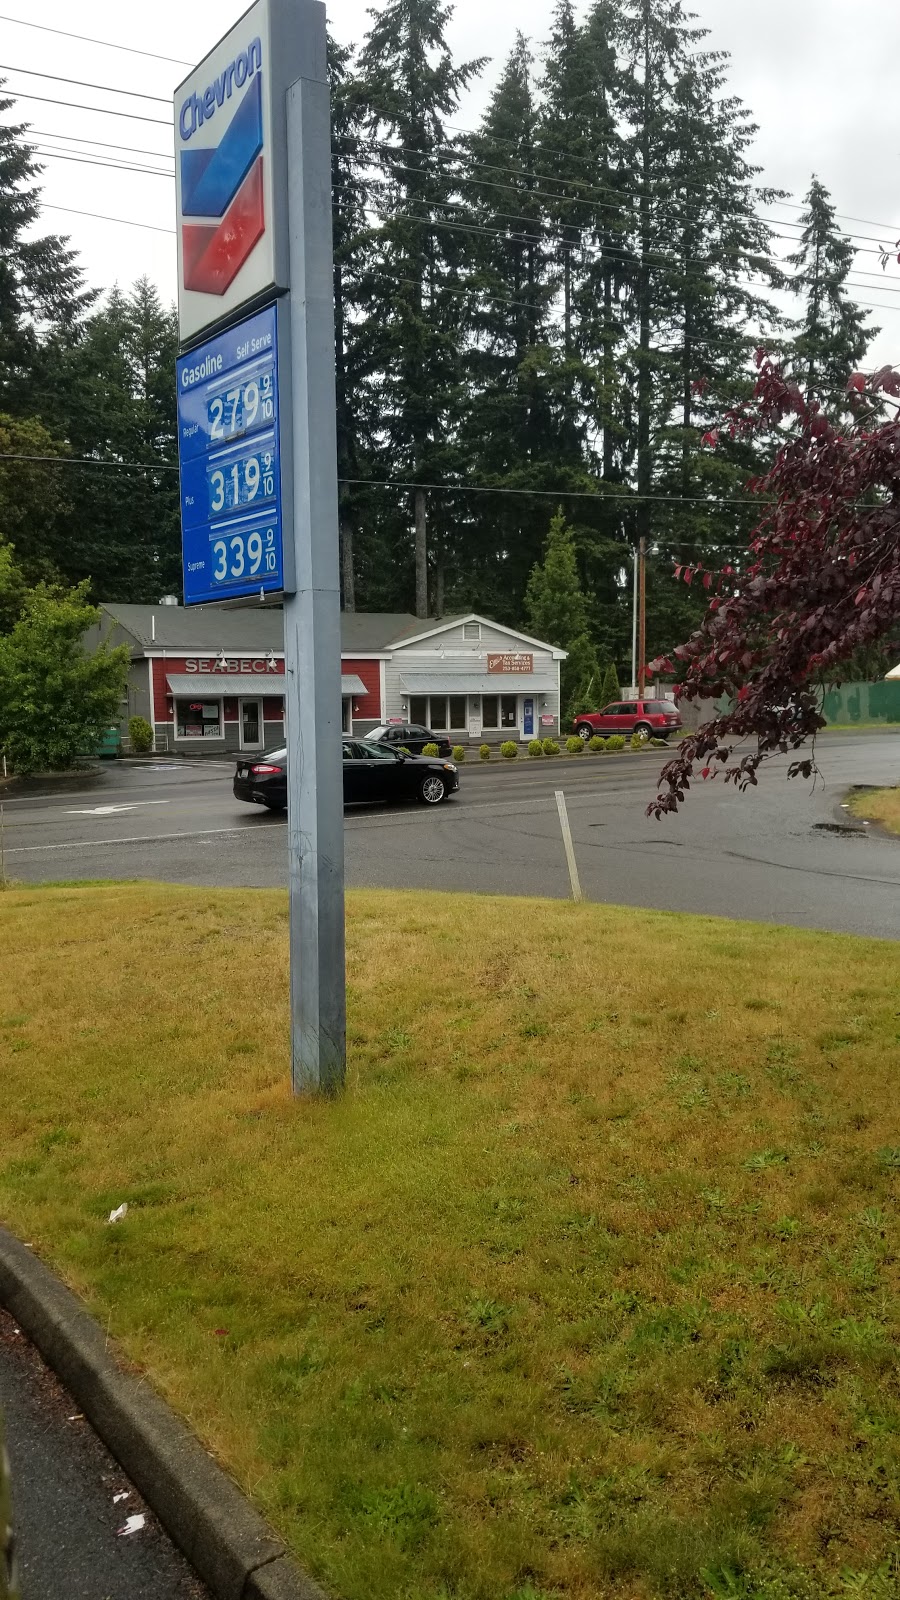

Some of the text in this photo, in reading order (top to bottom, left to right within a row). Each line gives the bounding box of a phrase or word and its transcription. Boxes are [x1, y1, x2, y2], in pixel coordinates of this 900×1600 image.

[179, 36, 262, 141] Chevron
[236, 333, 272, 360] Self Serve
[181, 353, 223, 387] Gasoline
[210, 381, 259, 441] 279
[182, 424, 199, 438] Regular
[210, 457, 260, 511] 319
[184, 496, 195, 507] Plus
[187, 560, 206, 573] Supreme
[213, 531, 263, 581] 339
[185, 659, 279, 673] SEABECK
